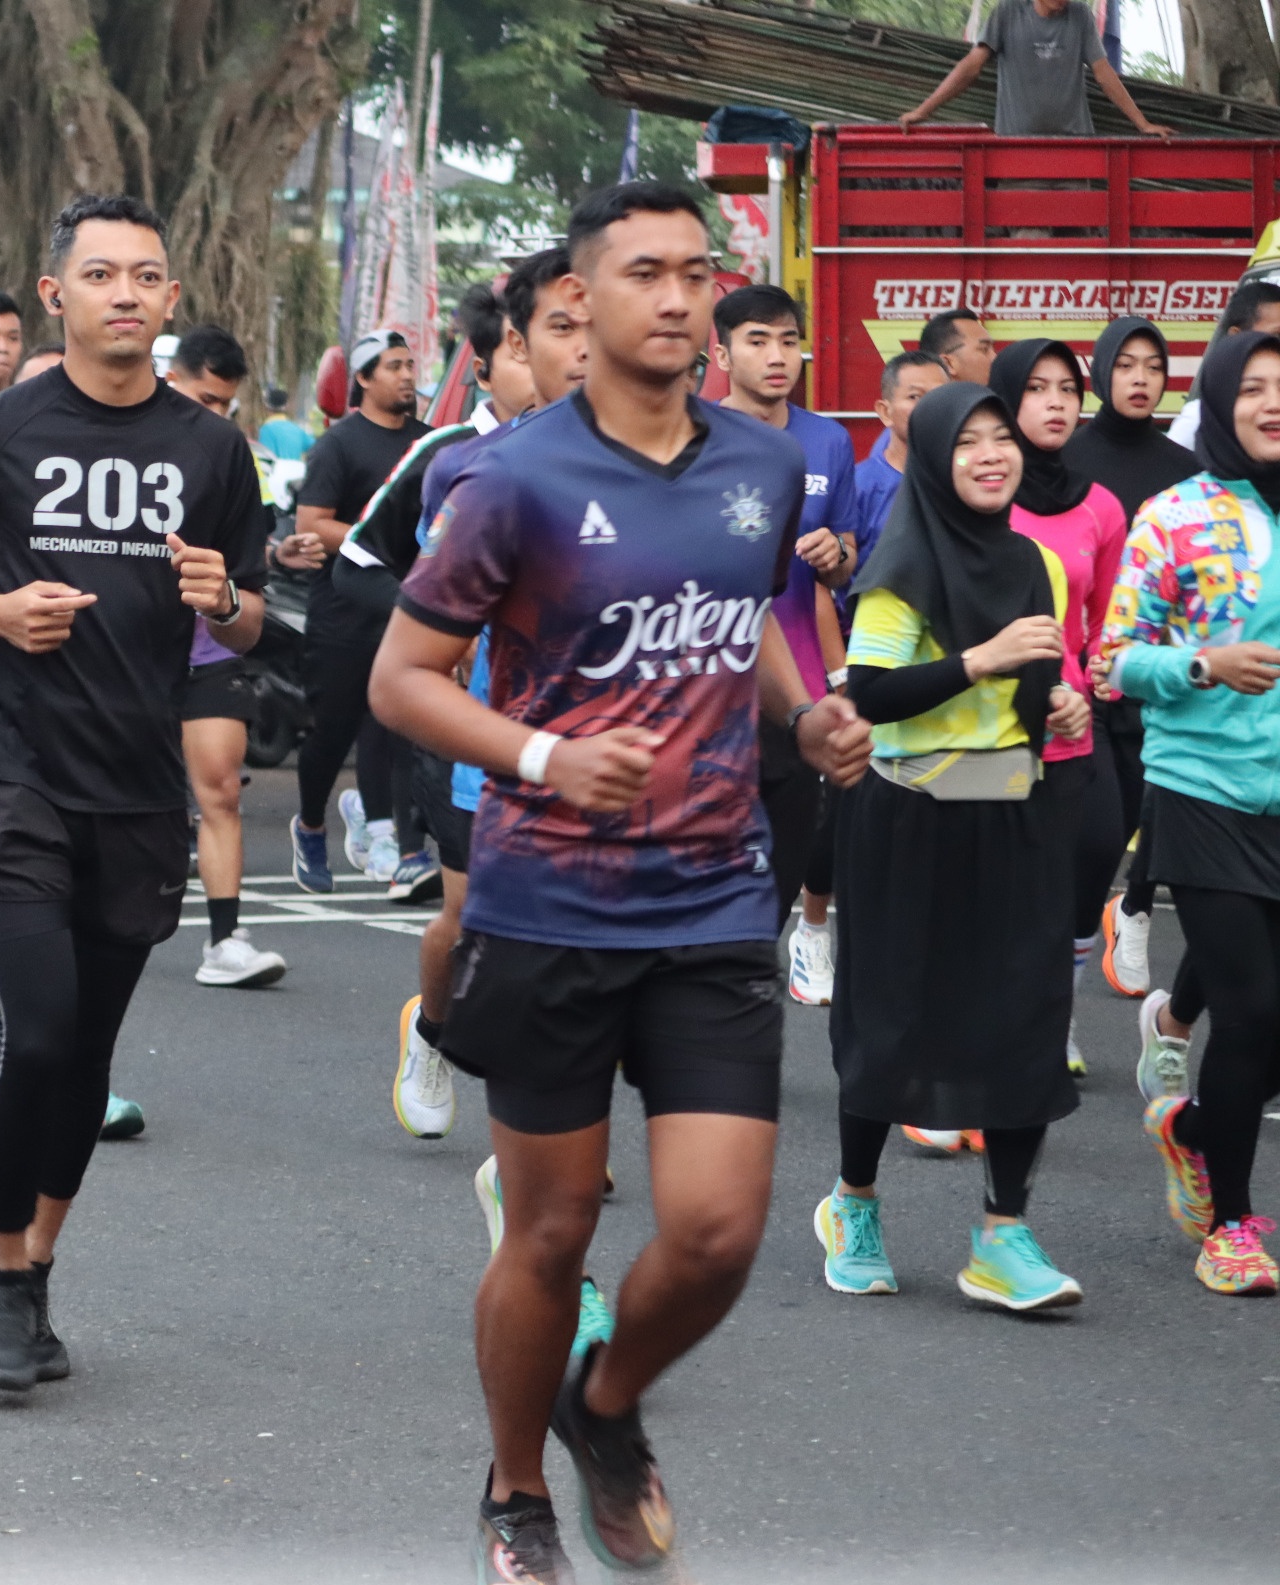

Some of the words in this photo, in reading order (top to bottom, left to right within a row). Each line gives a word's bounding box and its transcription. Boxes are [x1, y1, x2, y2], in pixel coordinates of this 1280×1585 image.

[877, 283, 958, 310] THE
[967, 283, 1163, 310] ULTIMATE
[32, 456, 185, 534] 203
[29, 536, 118, 555] MECHANIZED
[576, 579, 773, 680] Jateng
